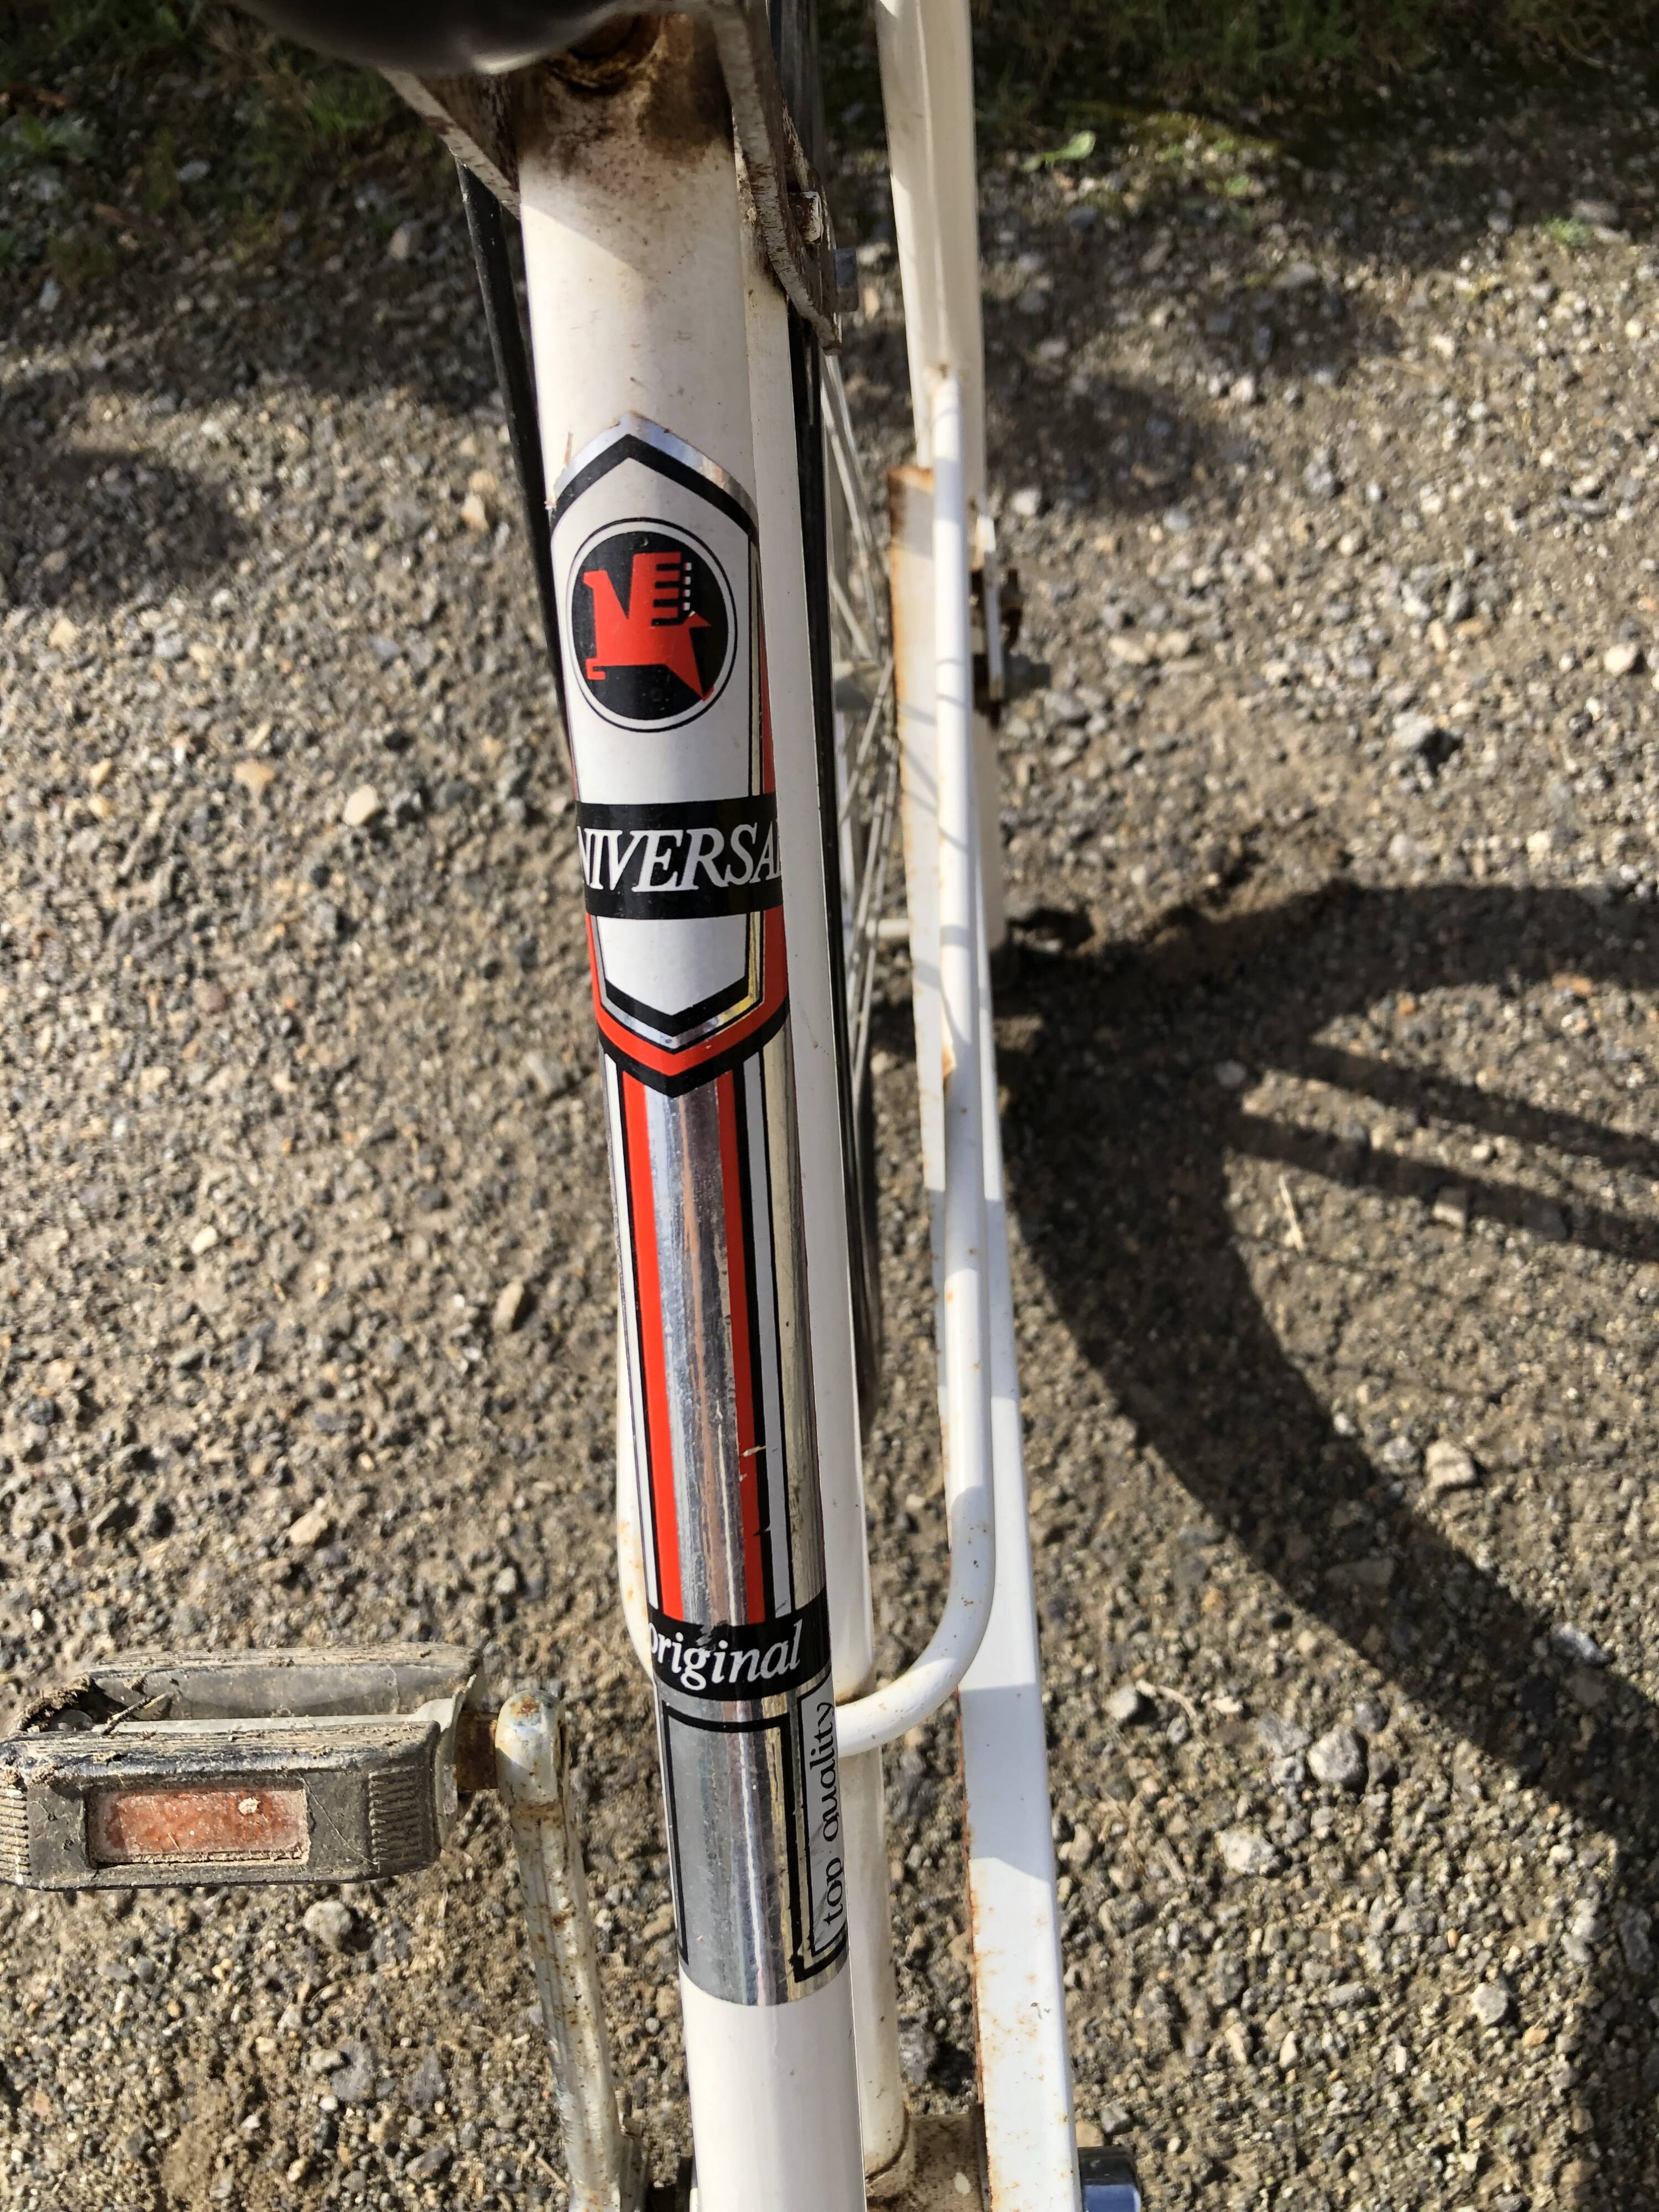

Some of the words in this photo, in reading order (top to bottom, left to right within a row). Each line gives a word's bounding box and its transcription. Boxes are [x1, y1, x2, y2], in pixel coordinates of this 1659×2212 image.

[649, 1619, 803, 1691] Original
[810, 1702, 839, 1841] quality
[823, 1857, 844, 1925] top
